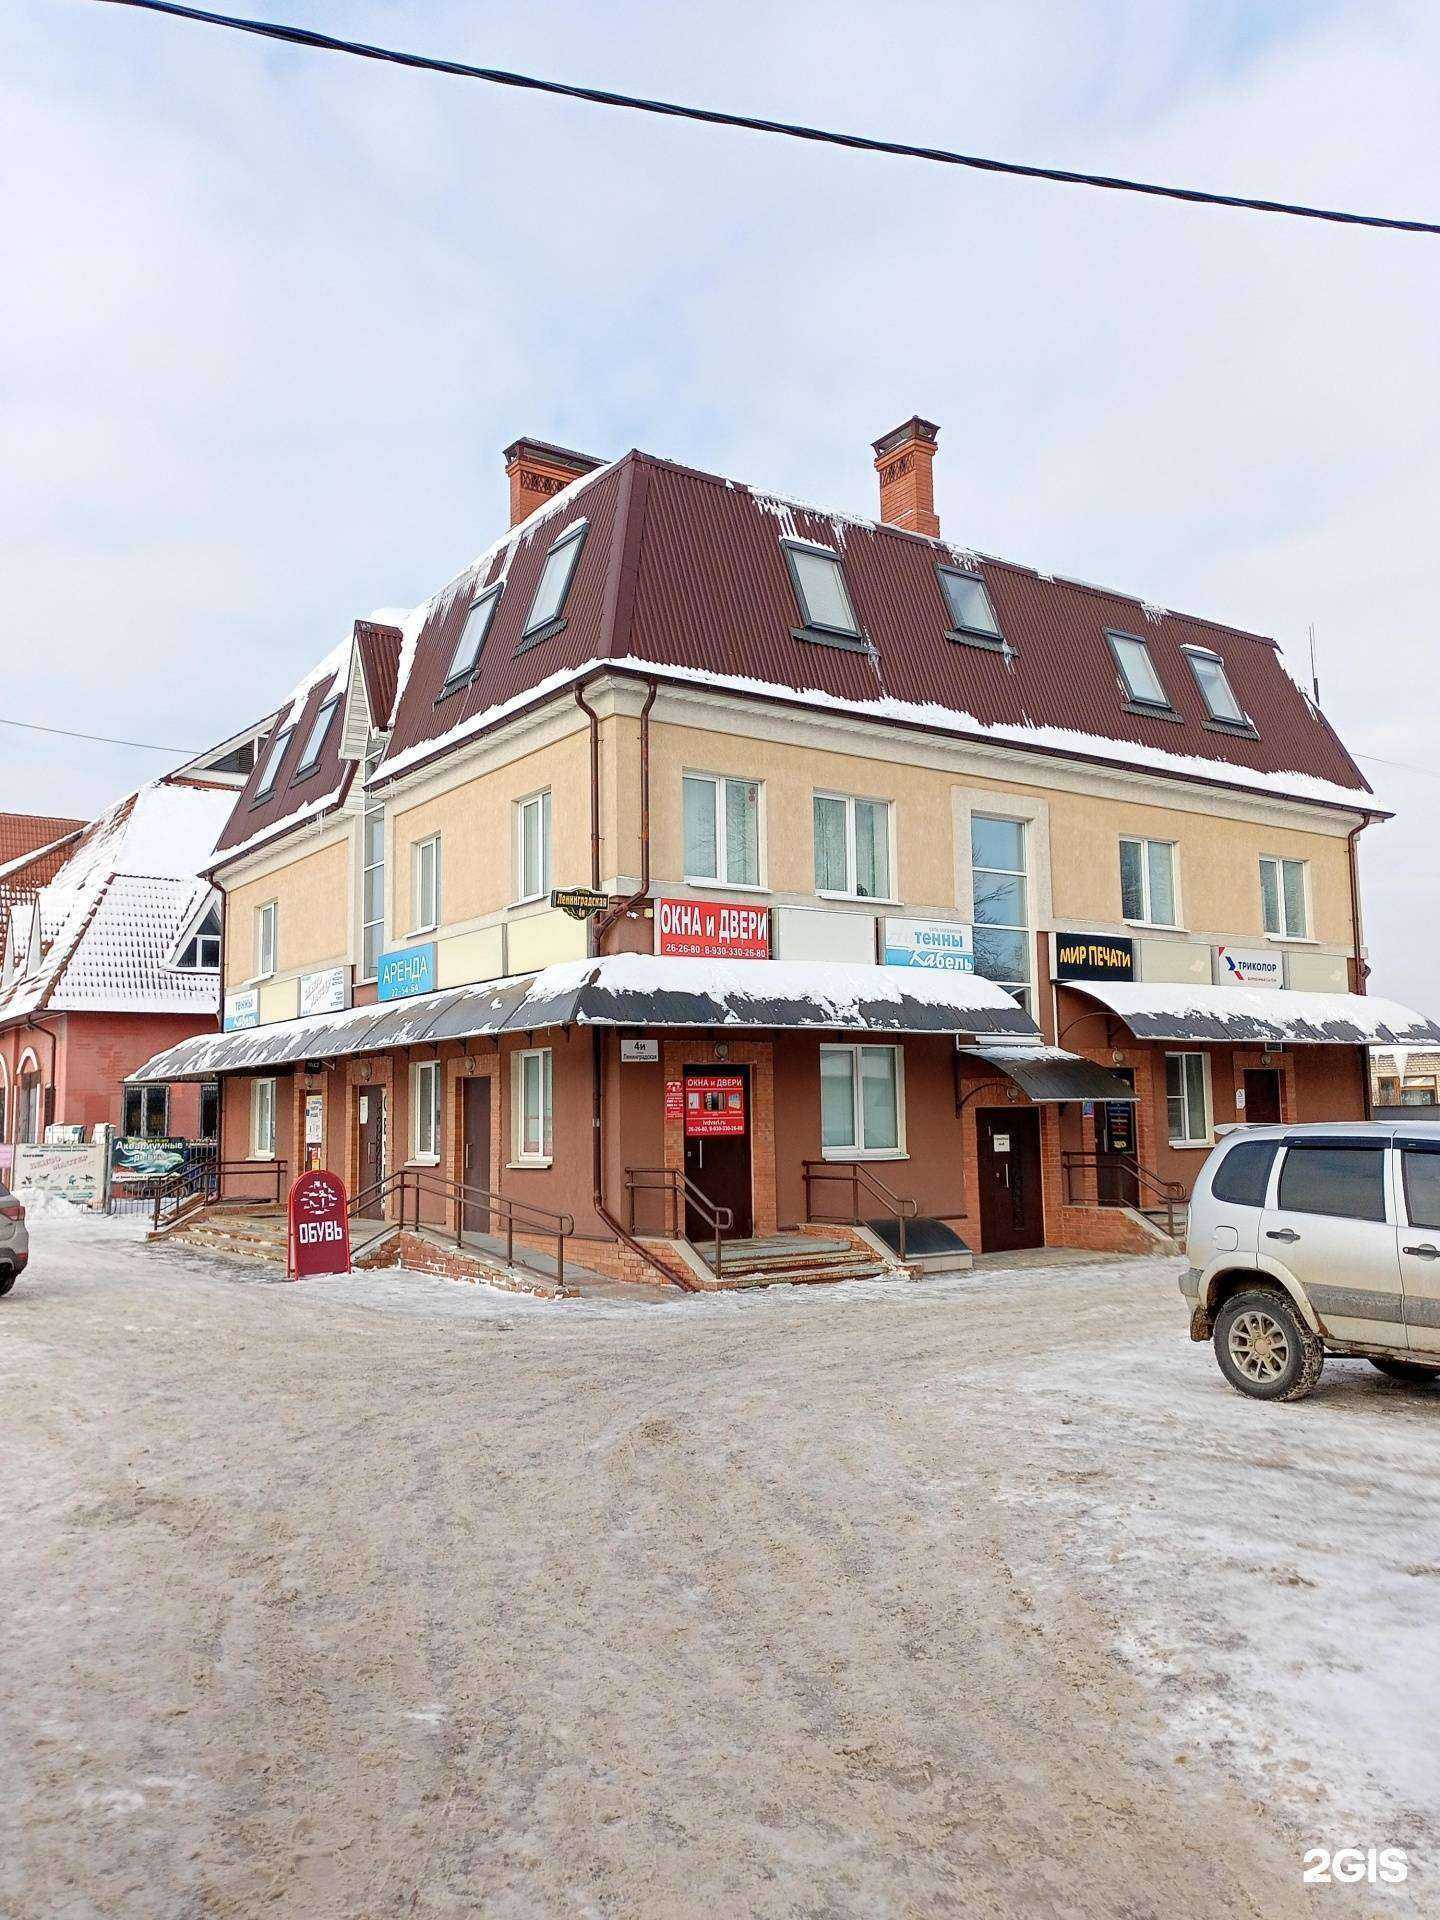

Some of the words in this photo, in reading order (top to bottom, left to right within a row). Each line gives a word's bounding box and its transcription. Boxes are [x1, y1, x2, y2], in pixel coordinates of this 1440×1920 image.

[557, 893, 607, 907] Ленинградская
[660, 903, 703, 937] ОКНА
[705, 916, 715, 937] и
[719, 909, 768, 944] ДВЕРИ
[665, 943, 701, 954] 26-26-80
[704, 945, 766, 958] 8-930-330-26-80
[1059, 946, 1086, 964] МИР
[1088, 946, 1131, 968] ПЕЧАТИ
[909, 949, 973, 971] Кабель
[1238, 961, 1277, 973] ТРИКОЛОР
[382, 955, 429, 986] АРЕНДА
[634, 1042, 646, 1051] 4и
[687, 1078, 709, 1087] ОКНА
[716, 1078, 742, 1088] ДВЕРИ
[299, 1220, 343, 1244] ОБУВЬ
